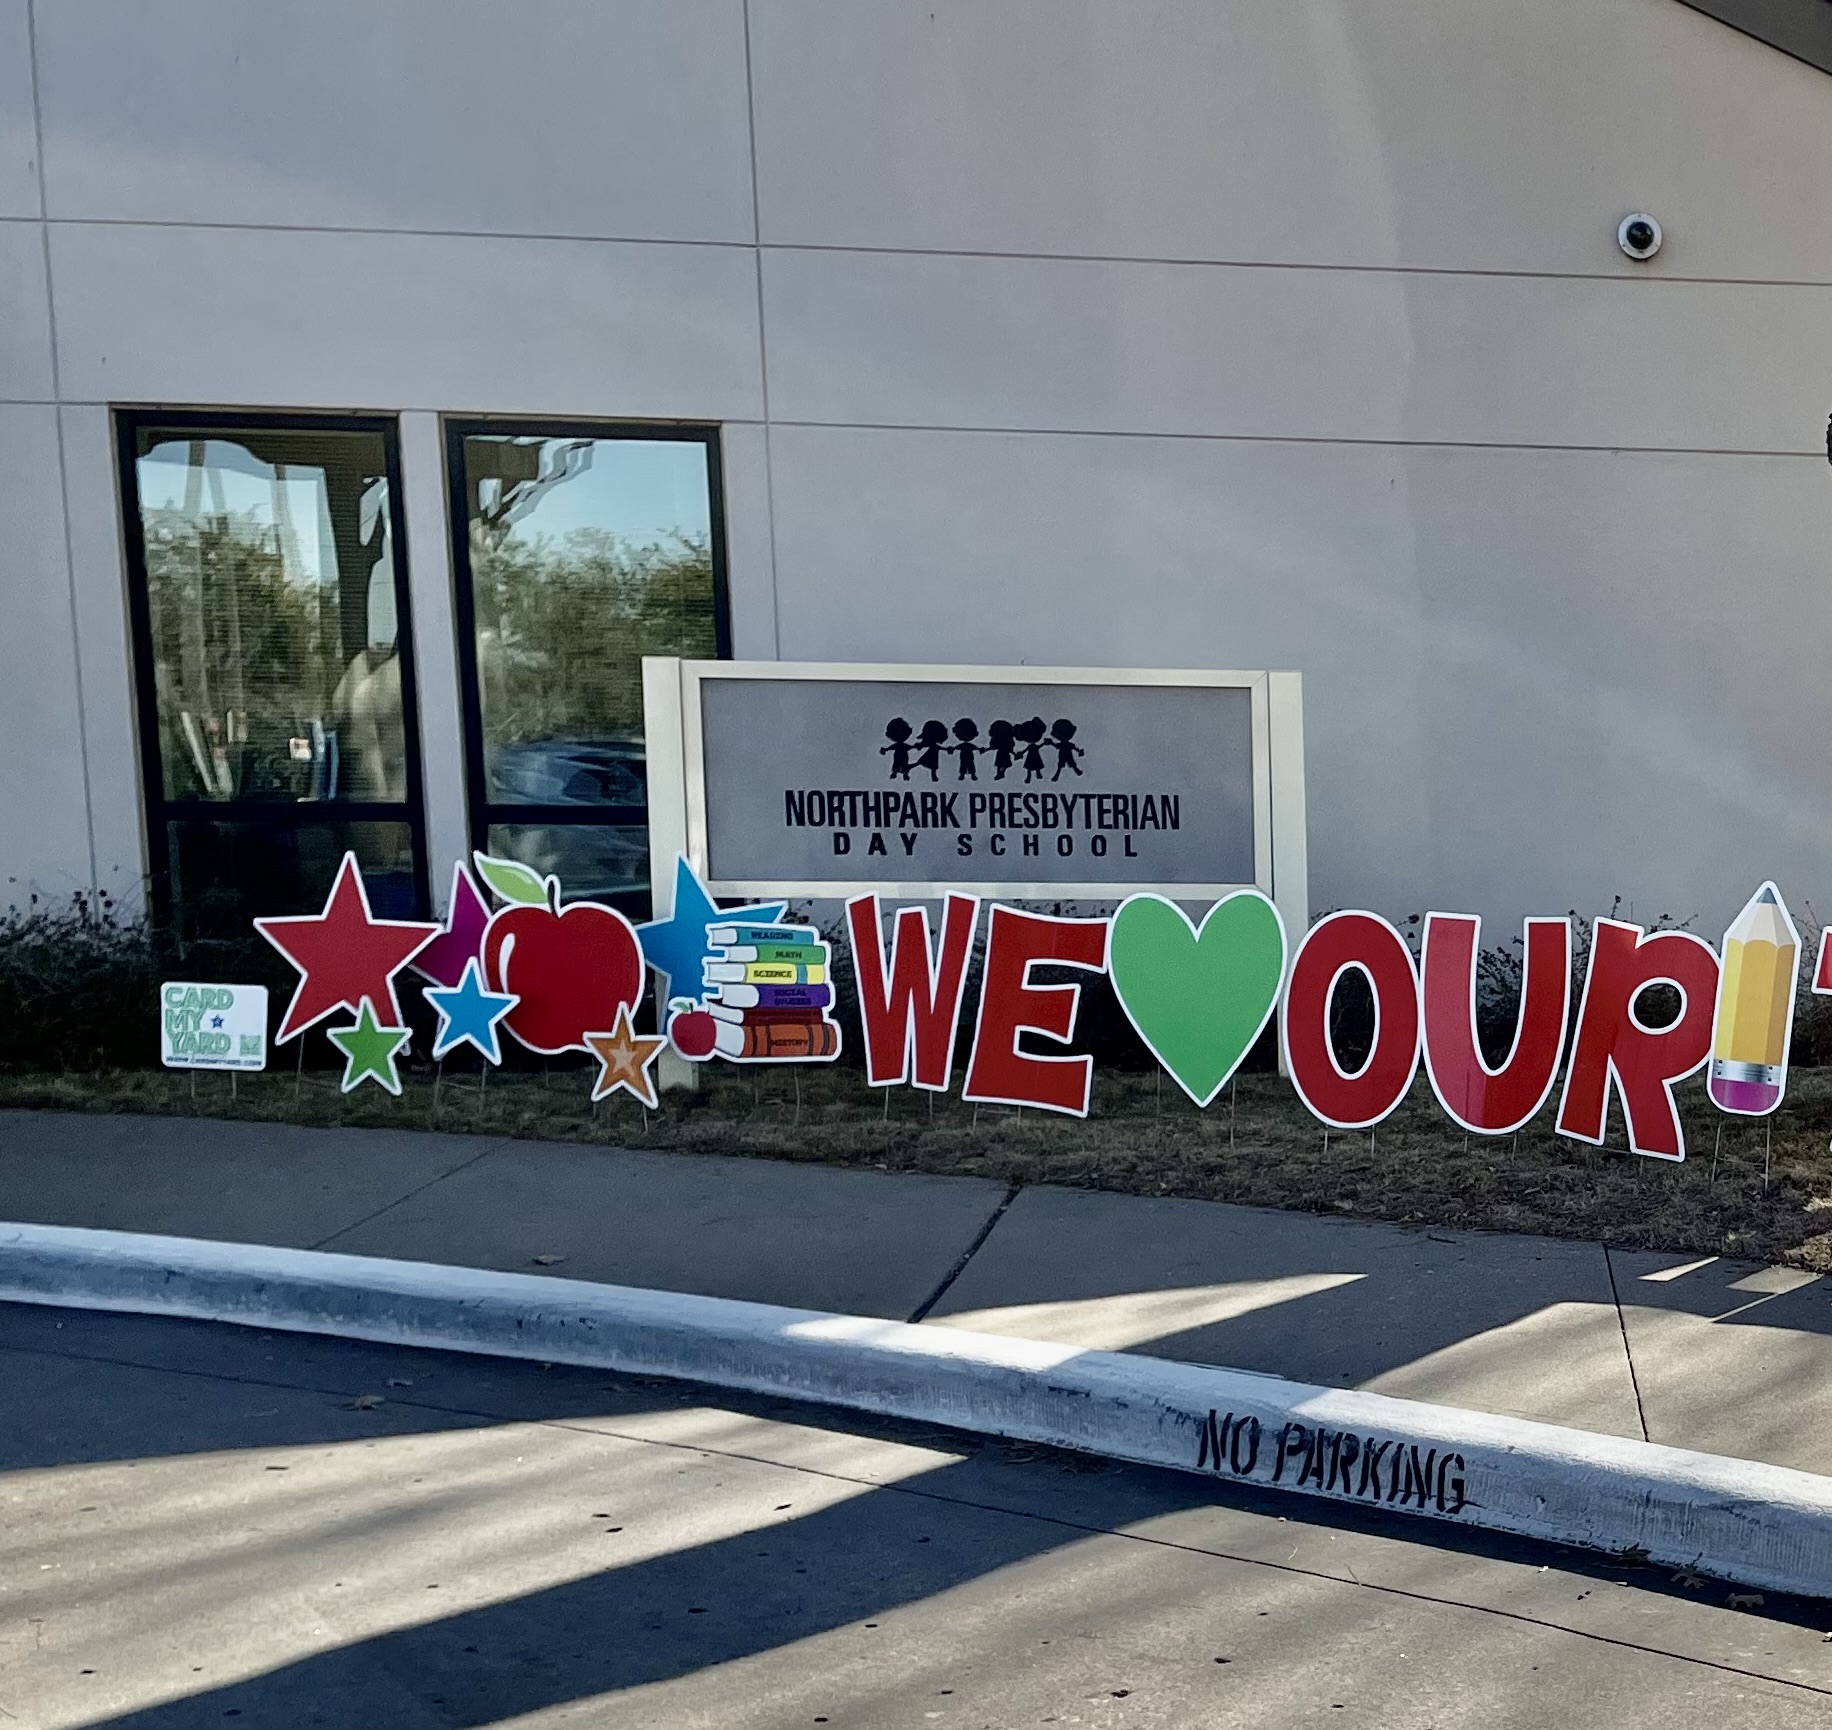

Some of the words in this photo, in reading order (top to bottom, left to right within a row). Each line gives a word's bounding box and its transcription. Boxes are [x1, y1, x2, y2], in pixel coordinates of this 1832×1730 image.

[784, 789, 961, 830] NORTHPARK
[969, 791, 1181, 832] PRESBYTERIAN
[832, 831, 919, 857] DAY
[956, 832, 1139, 859] SCHOOL
[751, 931, 793, 940] READING
[775, 951, 802, 959] MATH
[753, 970, 792, 978] SCIENCE
[165, 986, 234, 1011] CARD
[165, 1004, 207, 1032] MY
[845, 890, 1111, 1118] WE
[1282, 909, 1721, 1162] OUR
[167, 1029, 231, 1055] YARD
[1197, 1408, 1261, 1476] NO
[1272, 1421, 1466, 1514] PARKING
